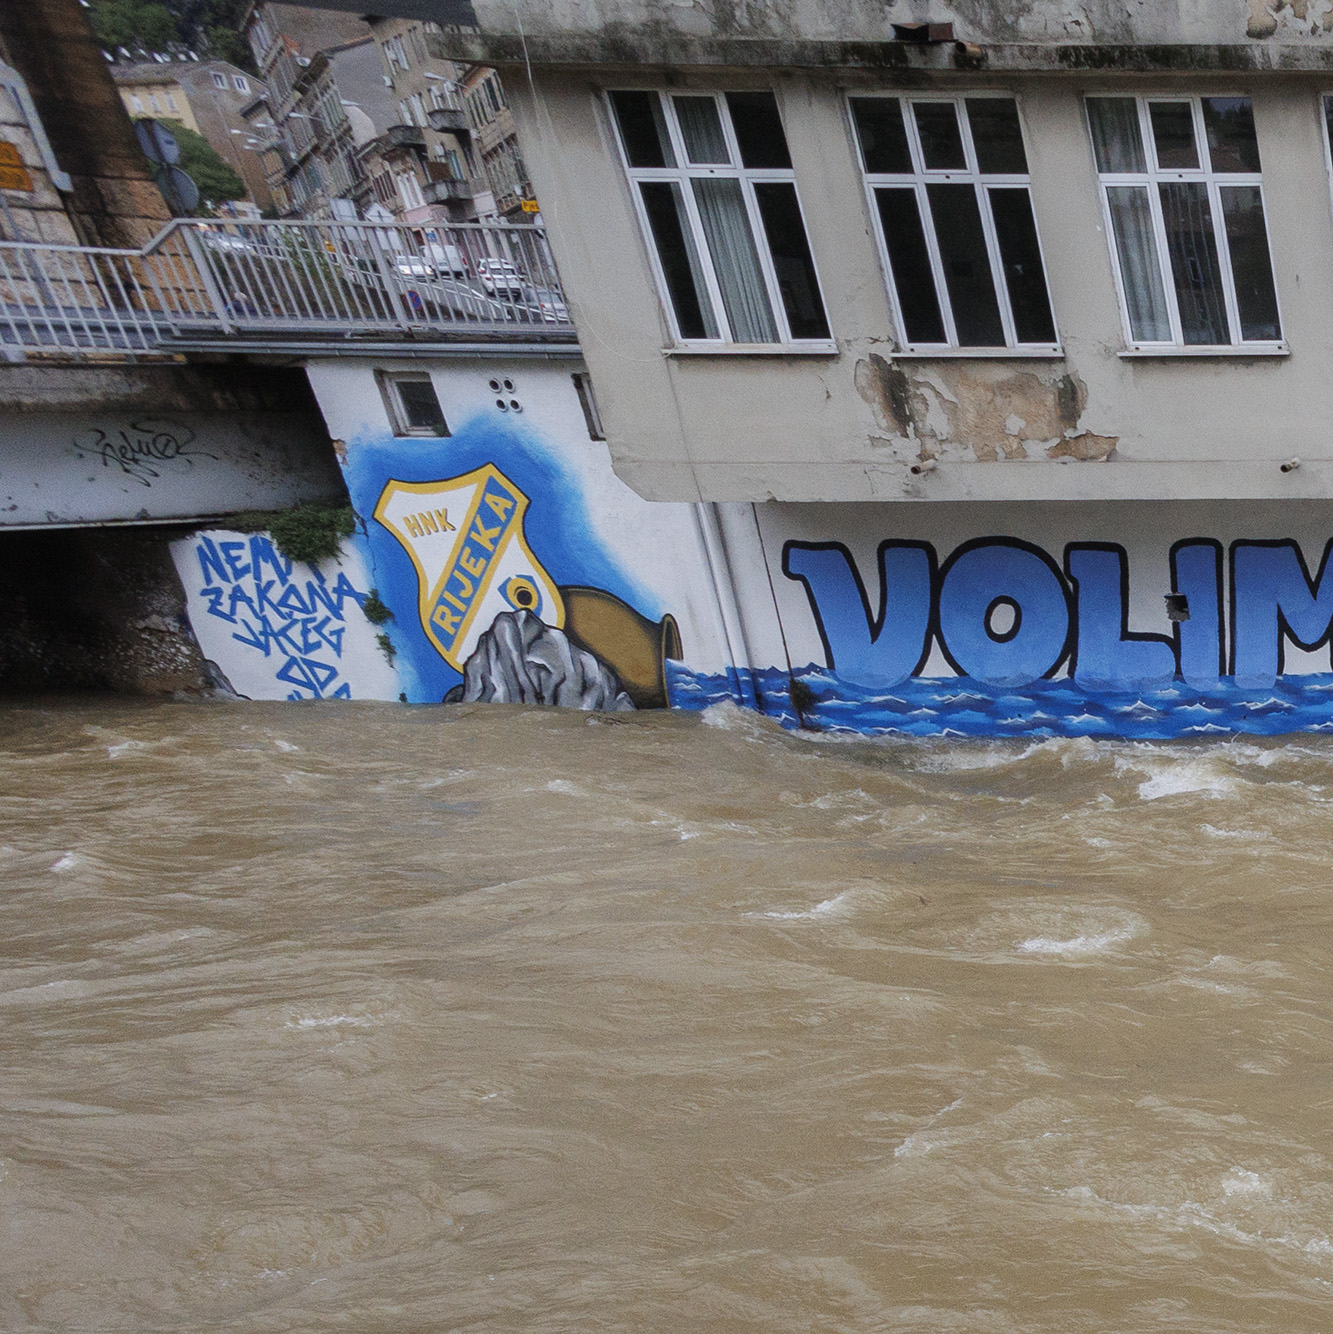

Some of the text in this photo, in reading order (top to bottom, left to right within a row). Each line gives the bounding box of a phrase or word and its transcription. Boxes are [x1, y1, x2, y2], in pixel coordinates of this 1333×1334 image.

[402, 508, 456, 538] HNK
[432, 493, 514, 635] RIJEKA
[199, 571, 372, 625] ZAKONA
[275, 655, 340, 698] OD
